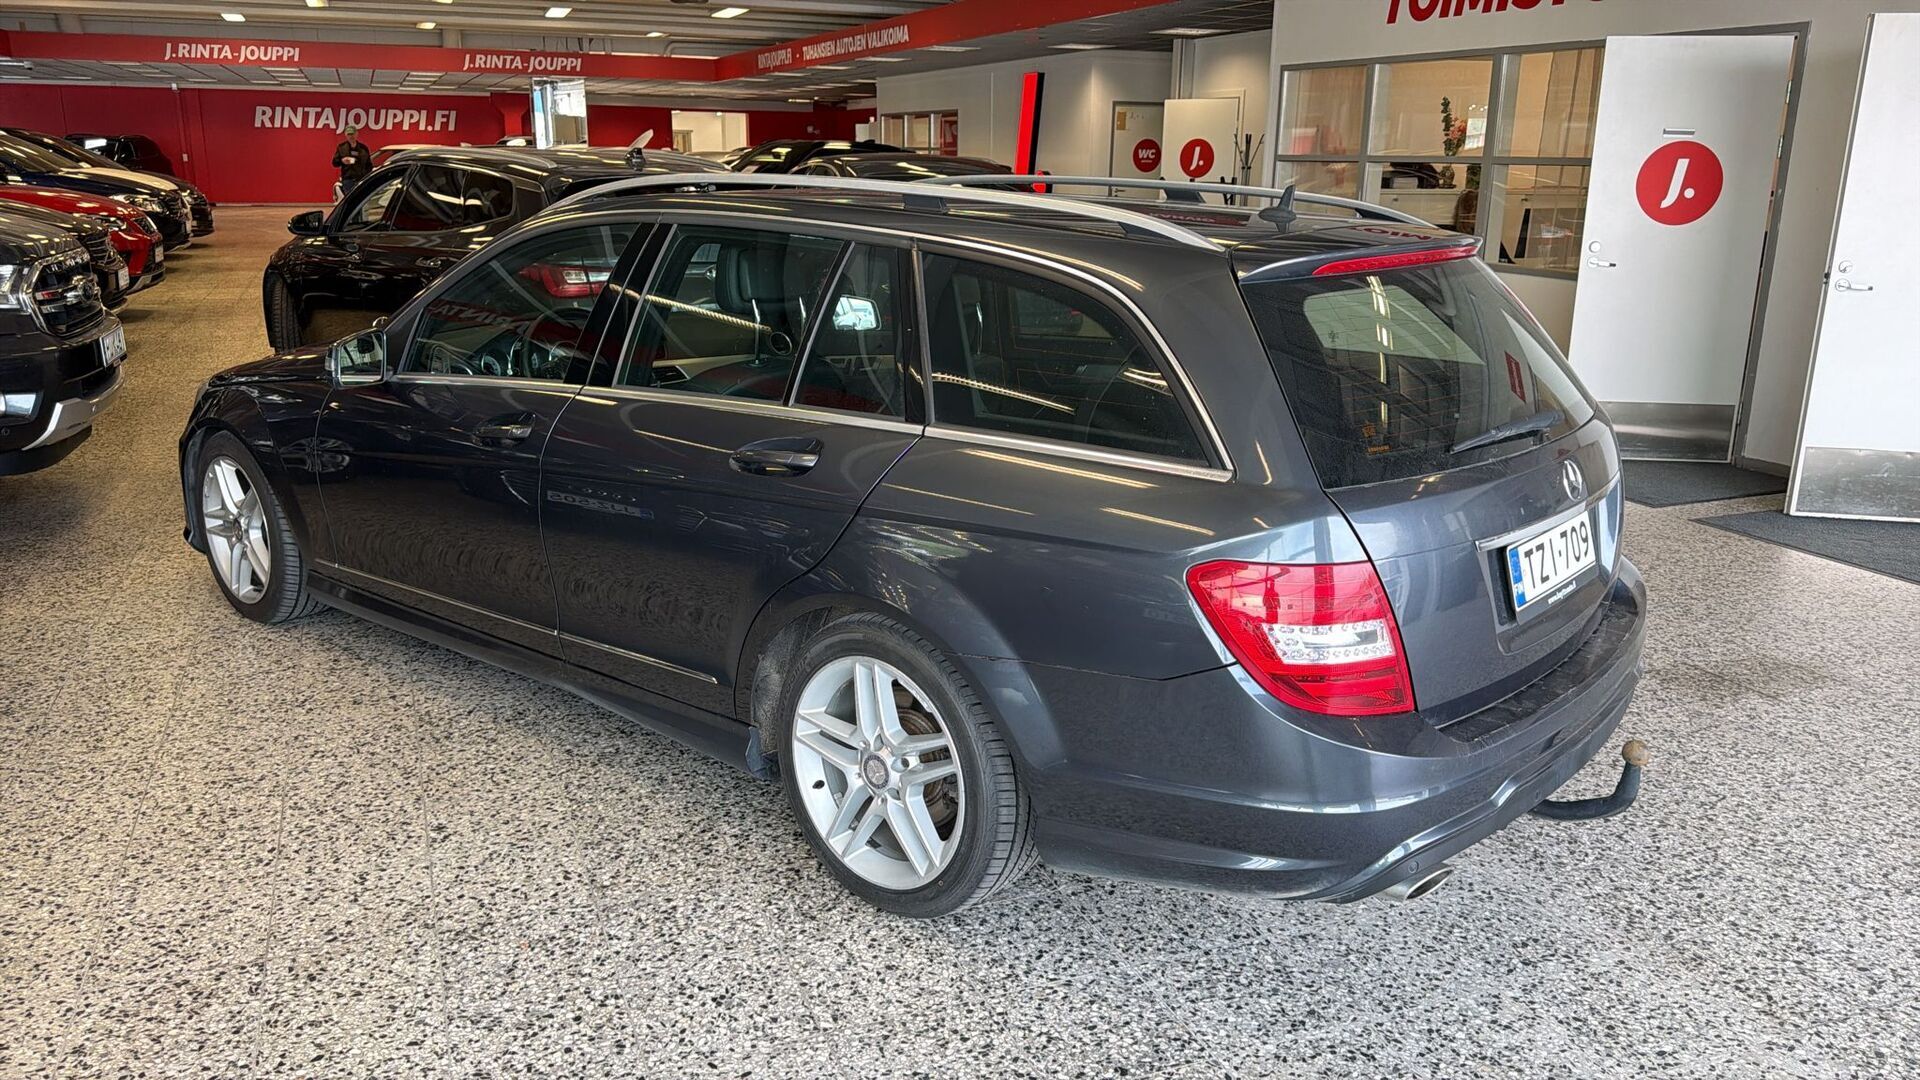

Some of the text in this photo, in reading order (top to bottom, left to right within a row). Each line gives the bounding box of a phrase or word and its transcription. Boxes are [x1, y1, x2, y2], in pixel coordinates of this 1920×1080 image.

[164, 42, 300, 63] J.RINTA-JOUPPI
[802, 40, 836, 61] TUHANSIEN
[835, 33, 866, 56] AUTOJEN
[866, 24, 909, 50] VALIKOIMA
[463, 53, 582, 73] J.RINTA-JOUPPI
[254, 105, 457, 135] RINTAJOUPPI.FI
[1138, 148, 1157, 159] WC
